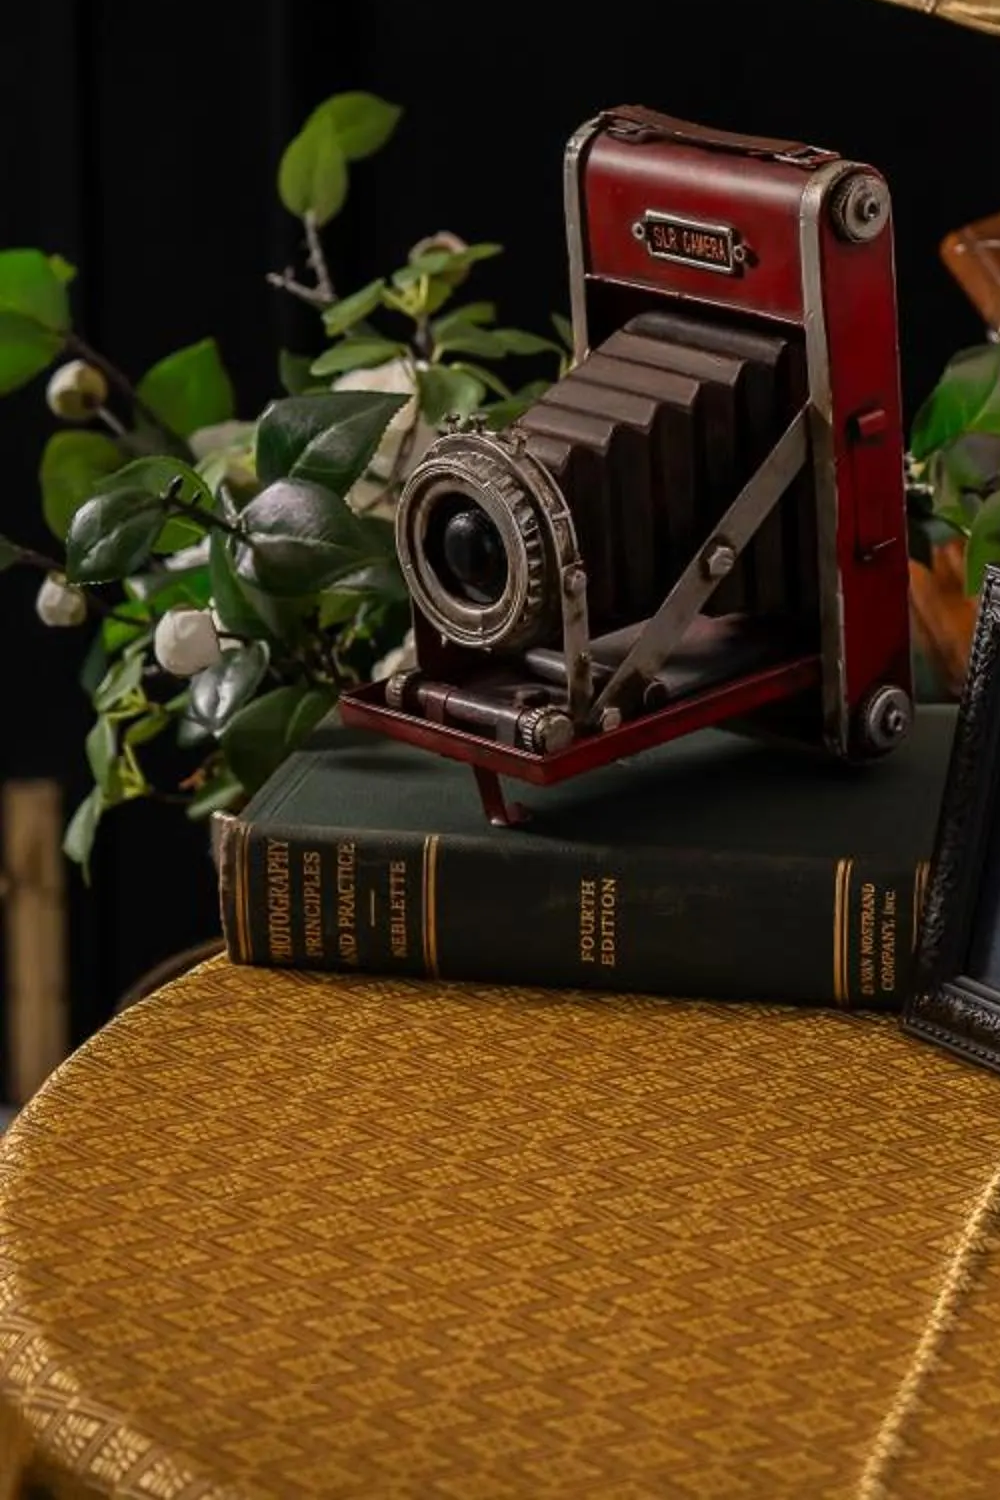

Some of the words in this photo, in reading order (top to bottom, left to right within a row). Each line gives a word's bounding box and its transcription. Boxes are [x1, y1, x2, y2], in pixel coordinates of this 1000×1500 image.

[683, 230, 727, 261] CAMERA
[303, 851, 322, 957] PRINCIPLES
[337, 840, 355, 928] PRACTICE
[390, 861, 406, 958] NEBLETTE
[581, 880, 595, 962] FOURTH
[601, 878, 616, 967] EDITION
[861, 883, 875, 955] NOSTRAND
[339, 930, 358, 964] AND
